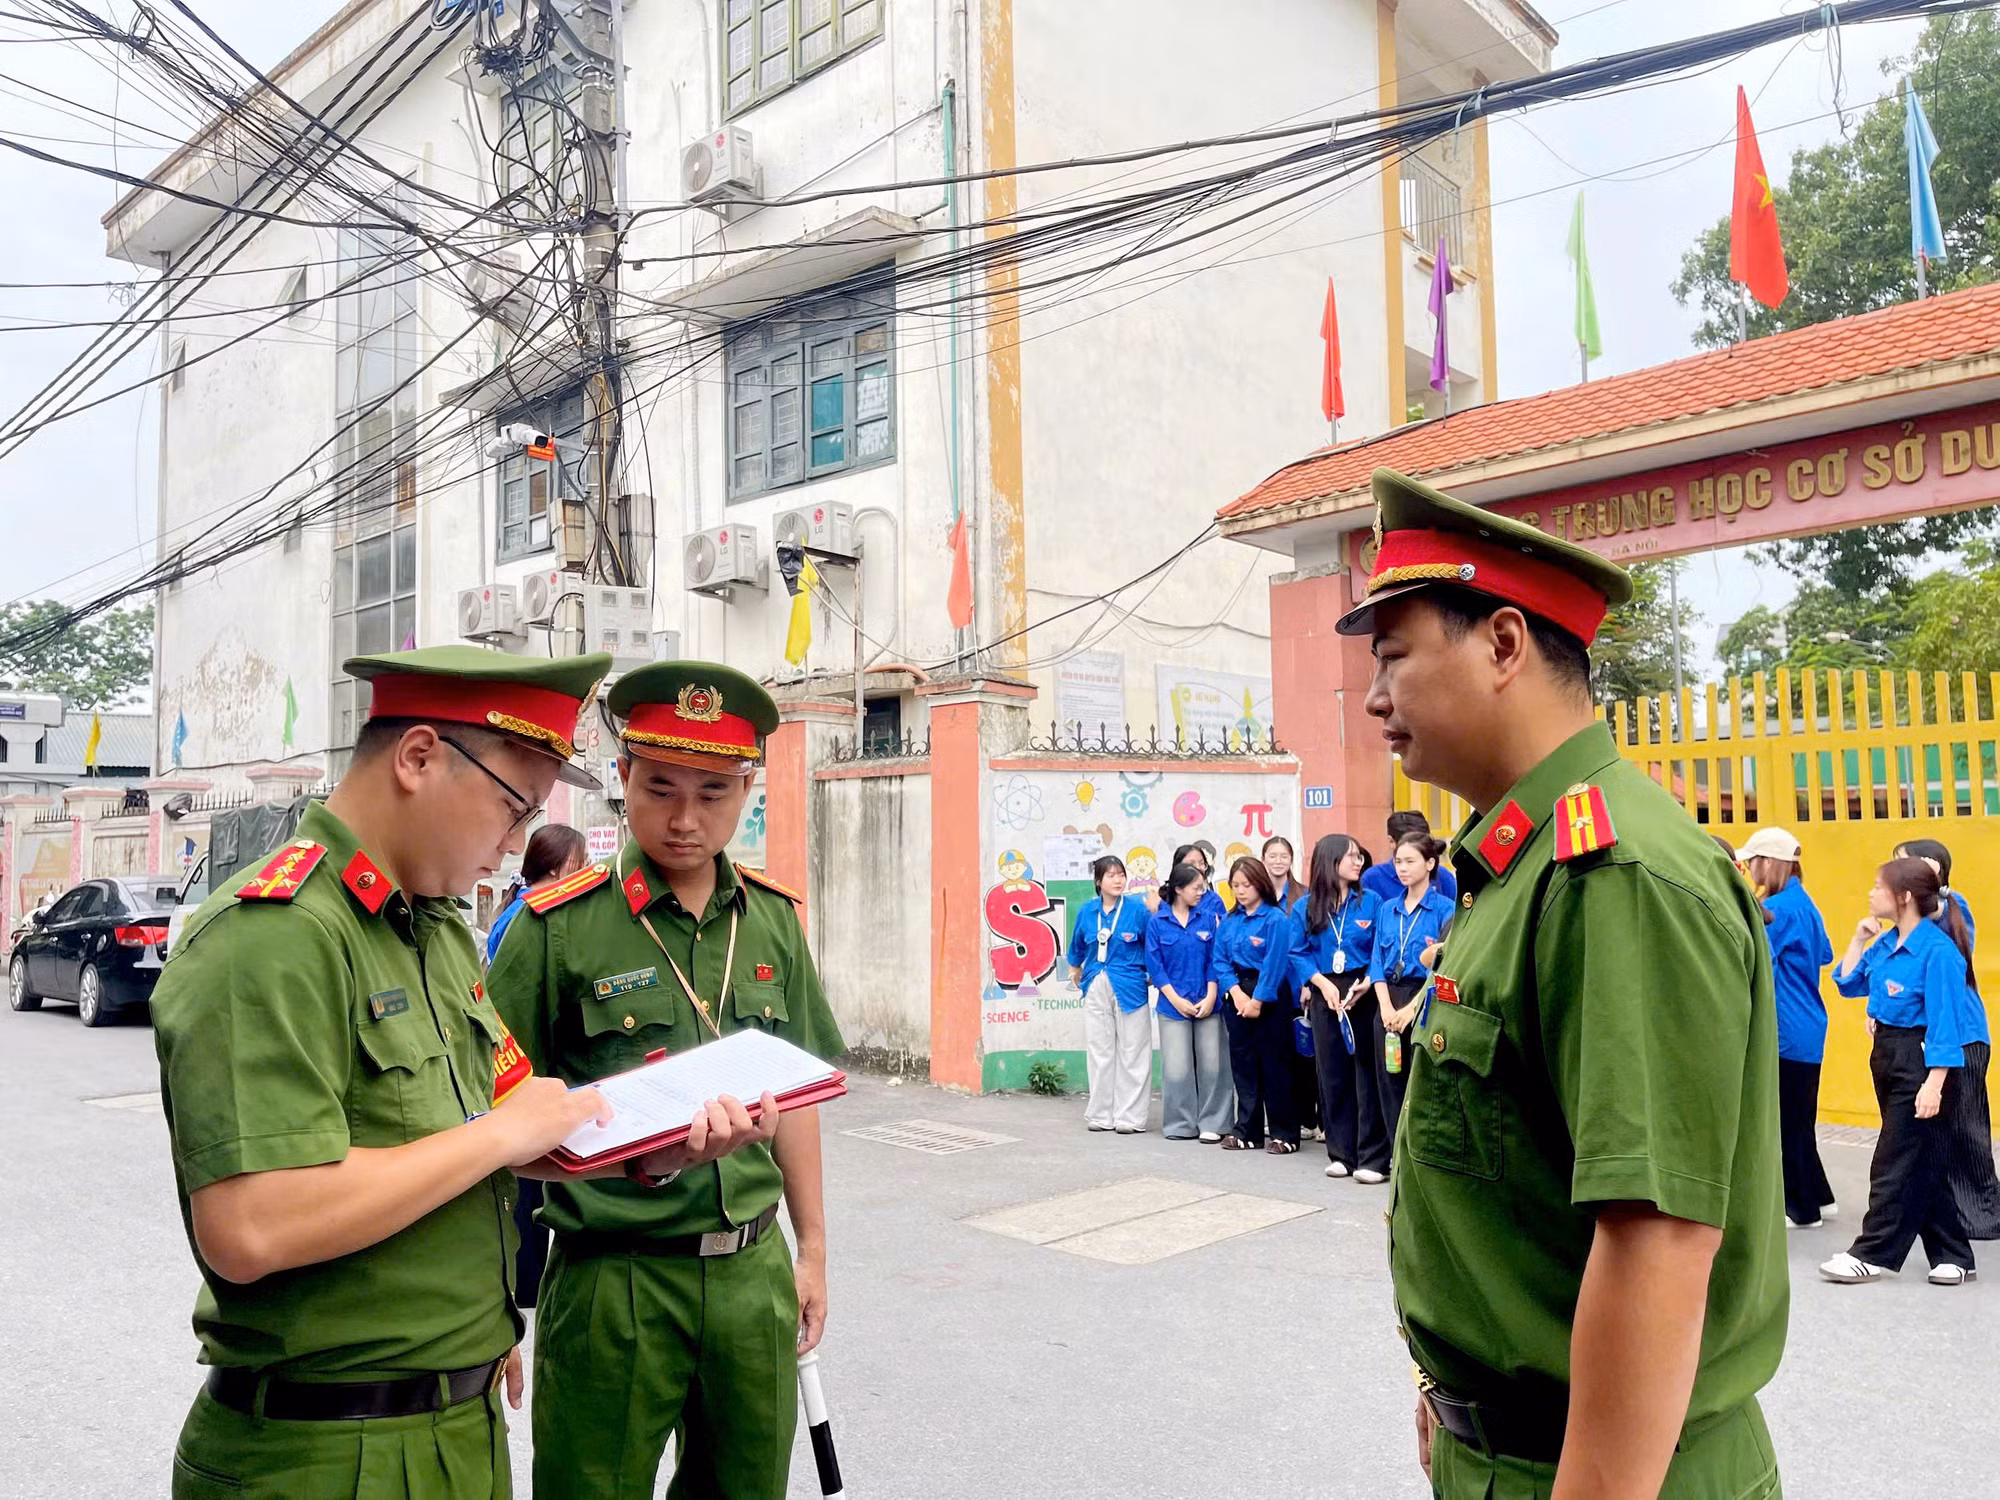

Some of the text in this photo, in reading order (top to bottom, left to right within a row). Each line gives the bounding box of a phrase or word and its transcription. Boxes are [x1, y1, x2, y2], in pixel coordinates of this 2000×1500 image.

[1552, 486, 1676, 541] TRUNG
[1688, 466, 1773, 523] HỌC
[1787, 447, 1849, 502] CƠ
[1862, 420, 1926, 490] SỞ
[1308, 789, 1329, 806] 101
[589, 830, 615, 839] CHO VAY
[987, 1010, 1030, 1024] SCIENCE
